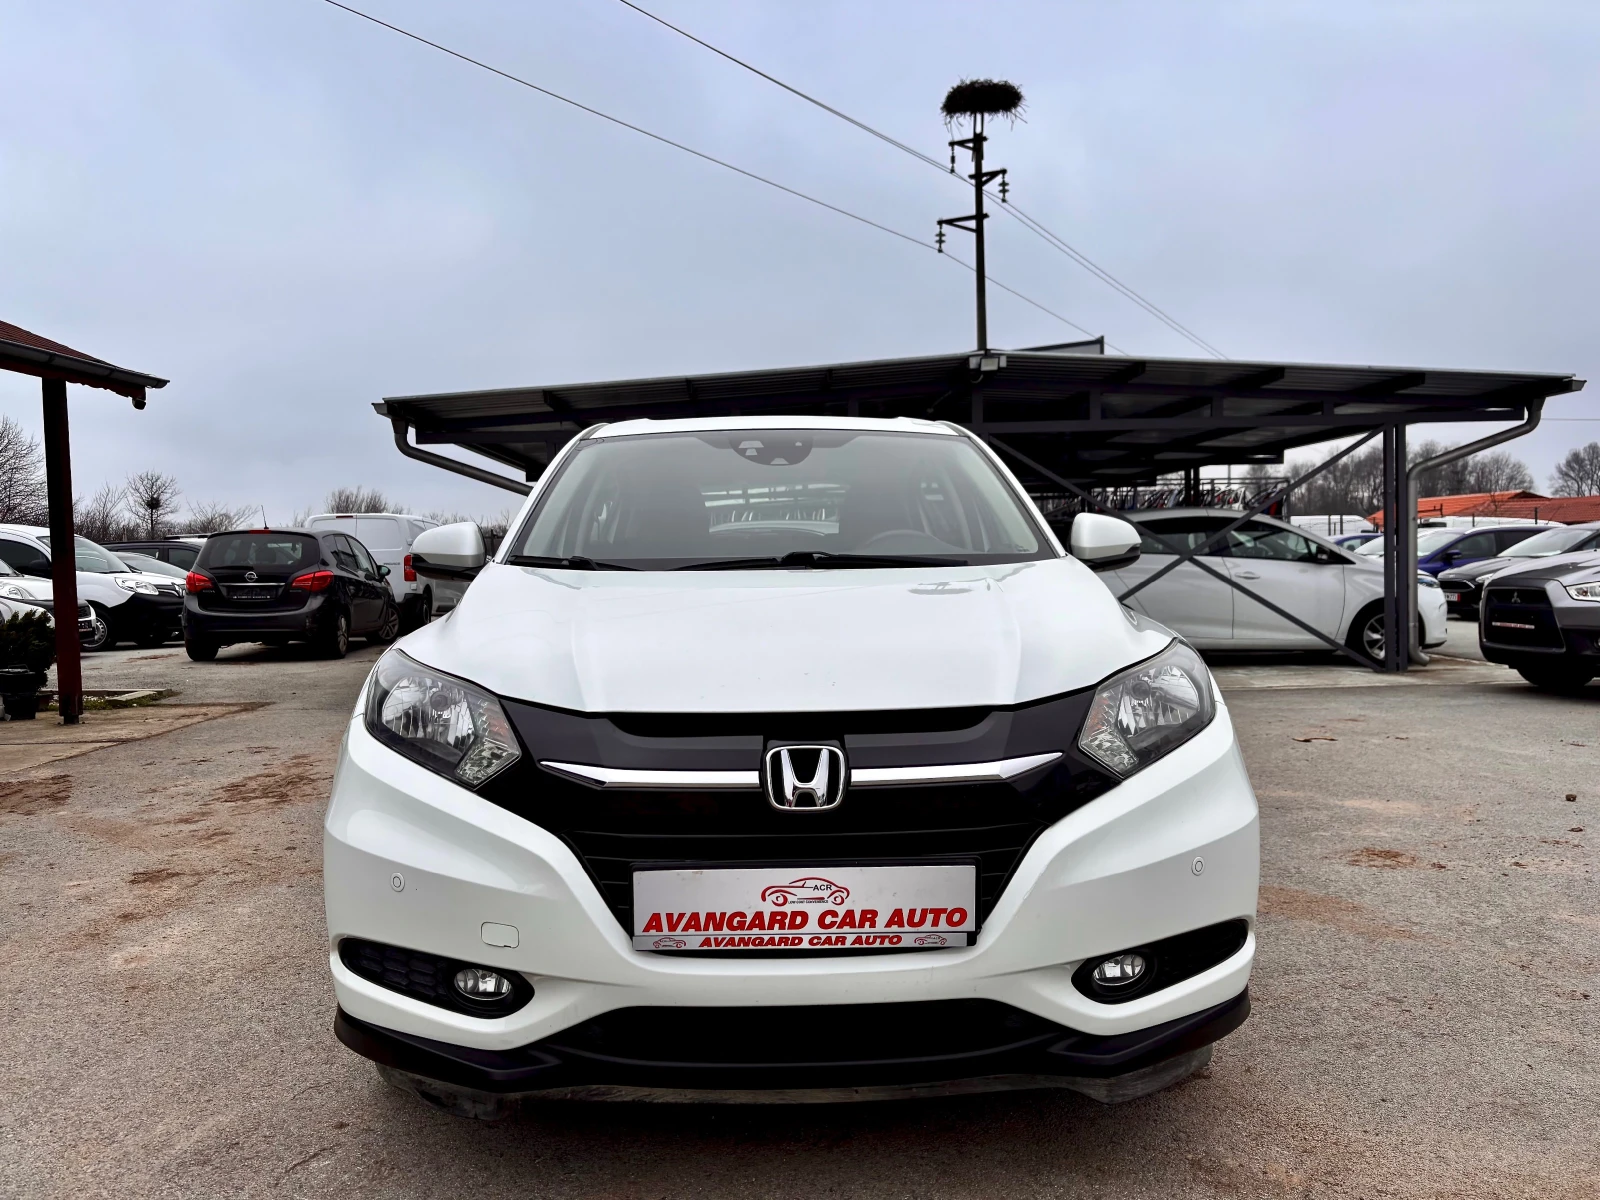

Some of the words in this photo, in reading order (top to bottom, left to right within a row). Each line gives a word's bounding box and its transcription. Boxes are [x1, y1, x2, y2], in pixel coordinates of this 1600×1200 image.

[642, 911, 809, 933] AVANGARD
[817, 909, 878, 930] CAR
[884, 907, 968, 928] AUTO
[698, 936, 803, 947] AVANGARD
[808, 935, 847, 946] CAR
[850, 934, 902, 946] AUTO
